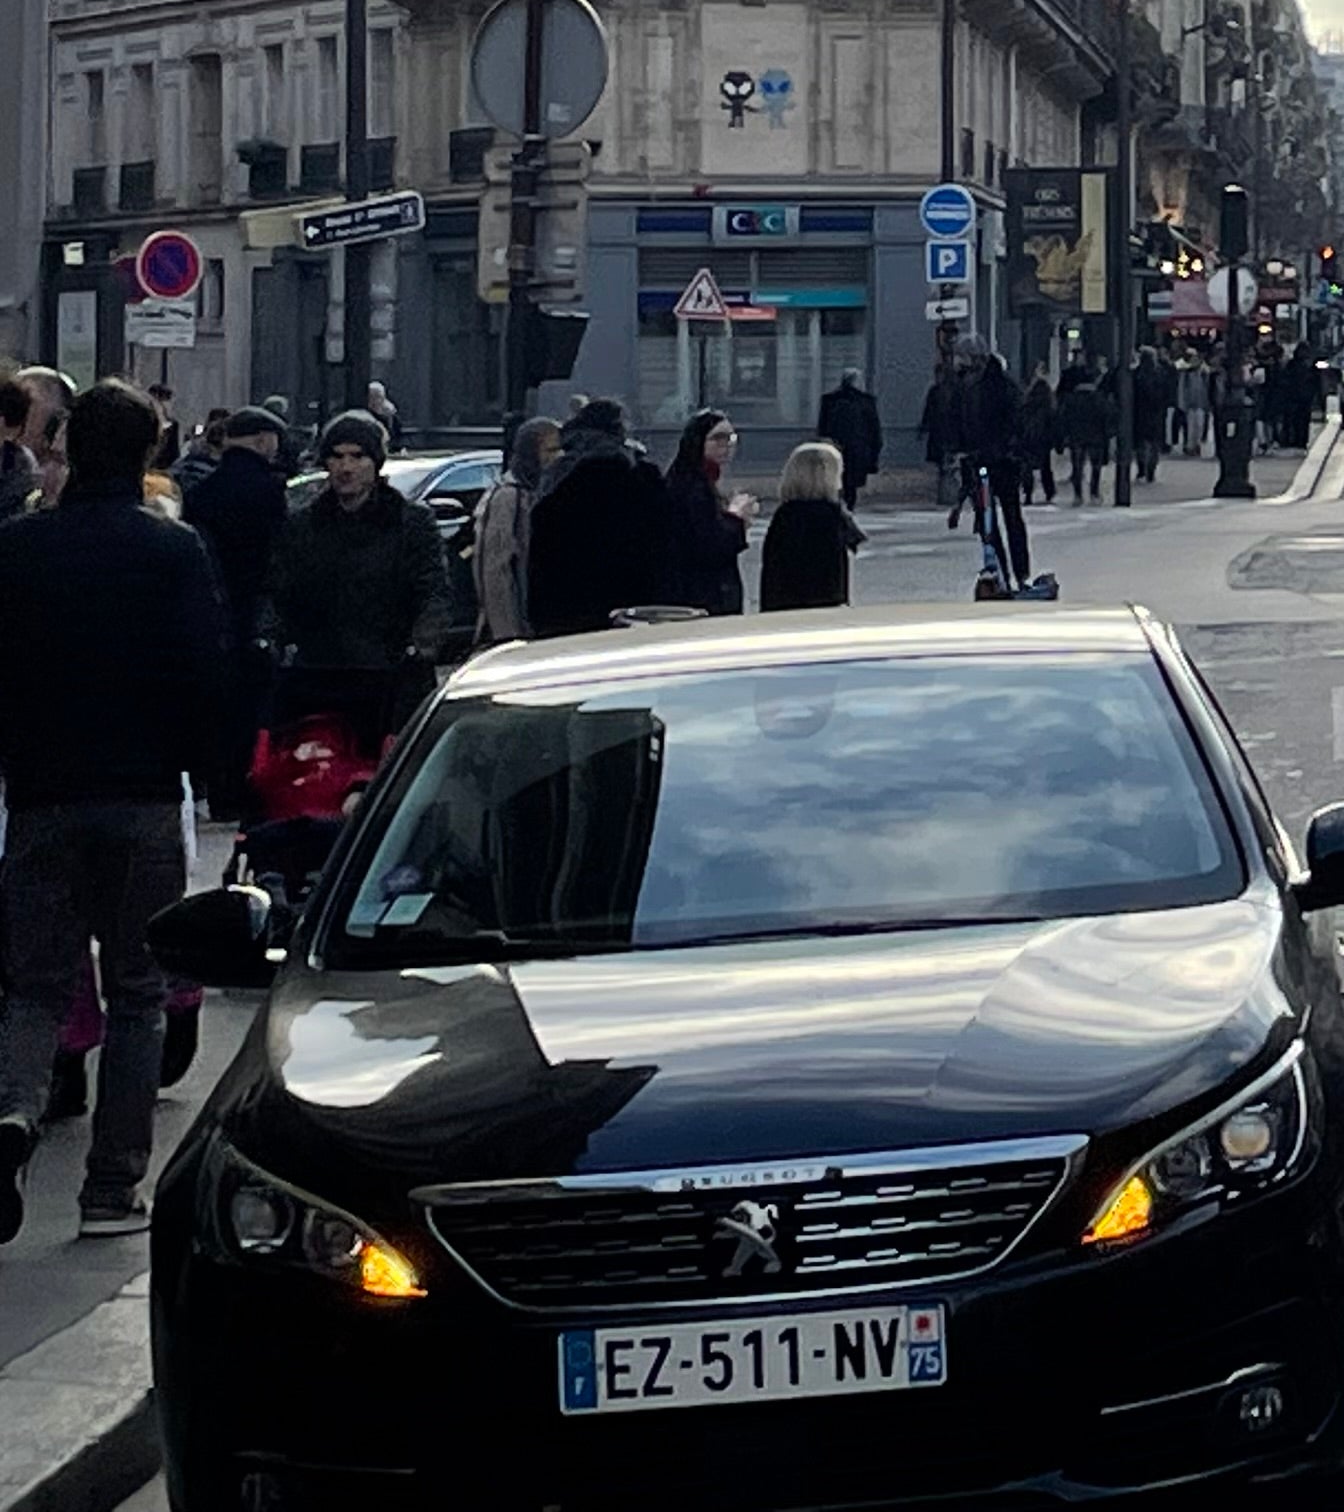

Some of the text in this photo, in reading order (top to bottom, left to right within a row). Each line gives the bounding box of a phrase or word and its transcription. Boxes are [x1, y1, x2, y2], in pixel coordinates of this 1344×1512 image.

[938, 248, 958, 274] P
[681, 1168, 815, 1190] PEUGEOT
[604, 1317, 900, 1400] EZ-511-NV
[910, 1346, 941, 1378] 75
